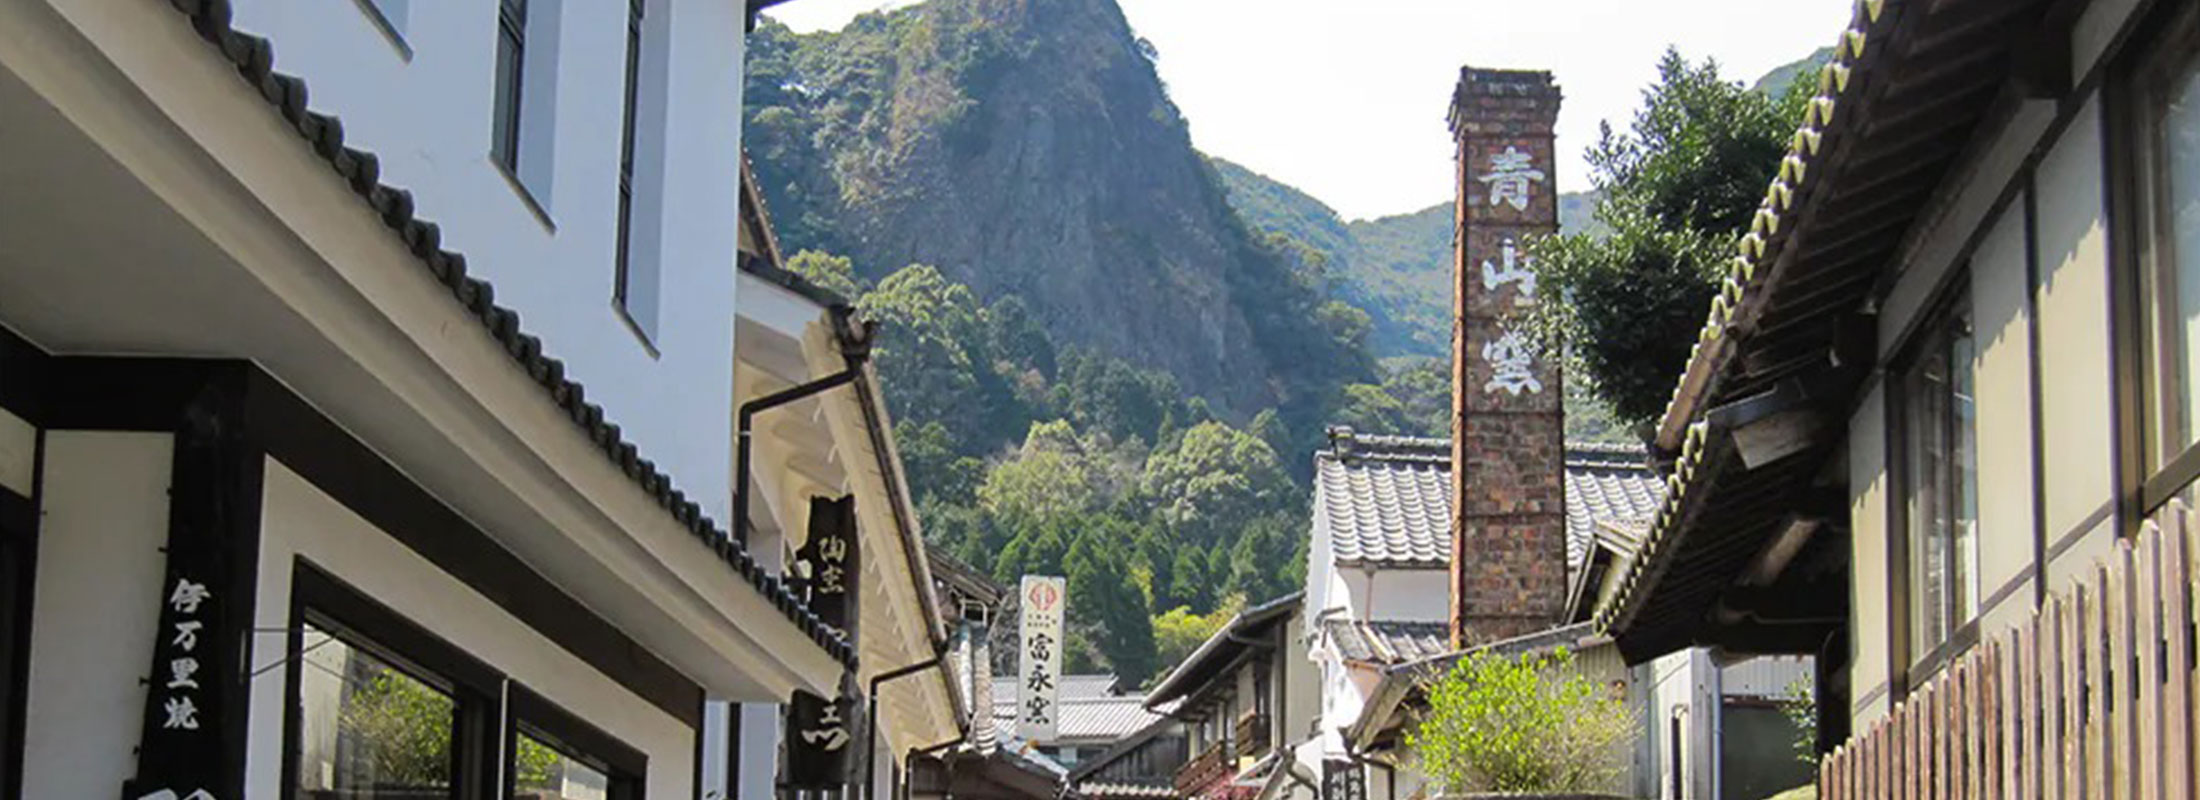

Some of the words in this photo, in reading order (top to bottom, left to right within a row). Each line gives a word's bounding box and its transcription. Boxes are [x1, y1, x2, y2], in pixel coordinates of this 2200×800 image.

[1477, 145, 1545, 396] 青山窯
[162, 577, 211, 730] 伊万里焼
[1025, 632, 1054, 724] 富永窯
